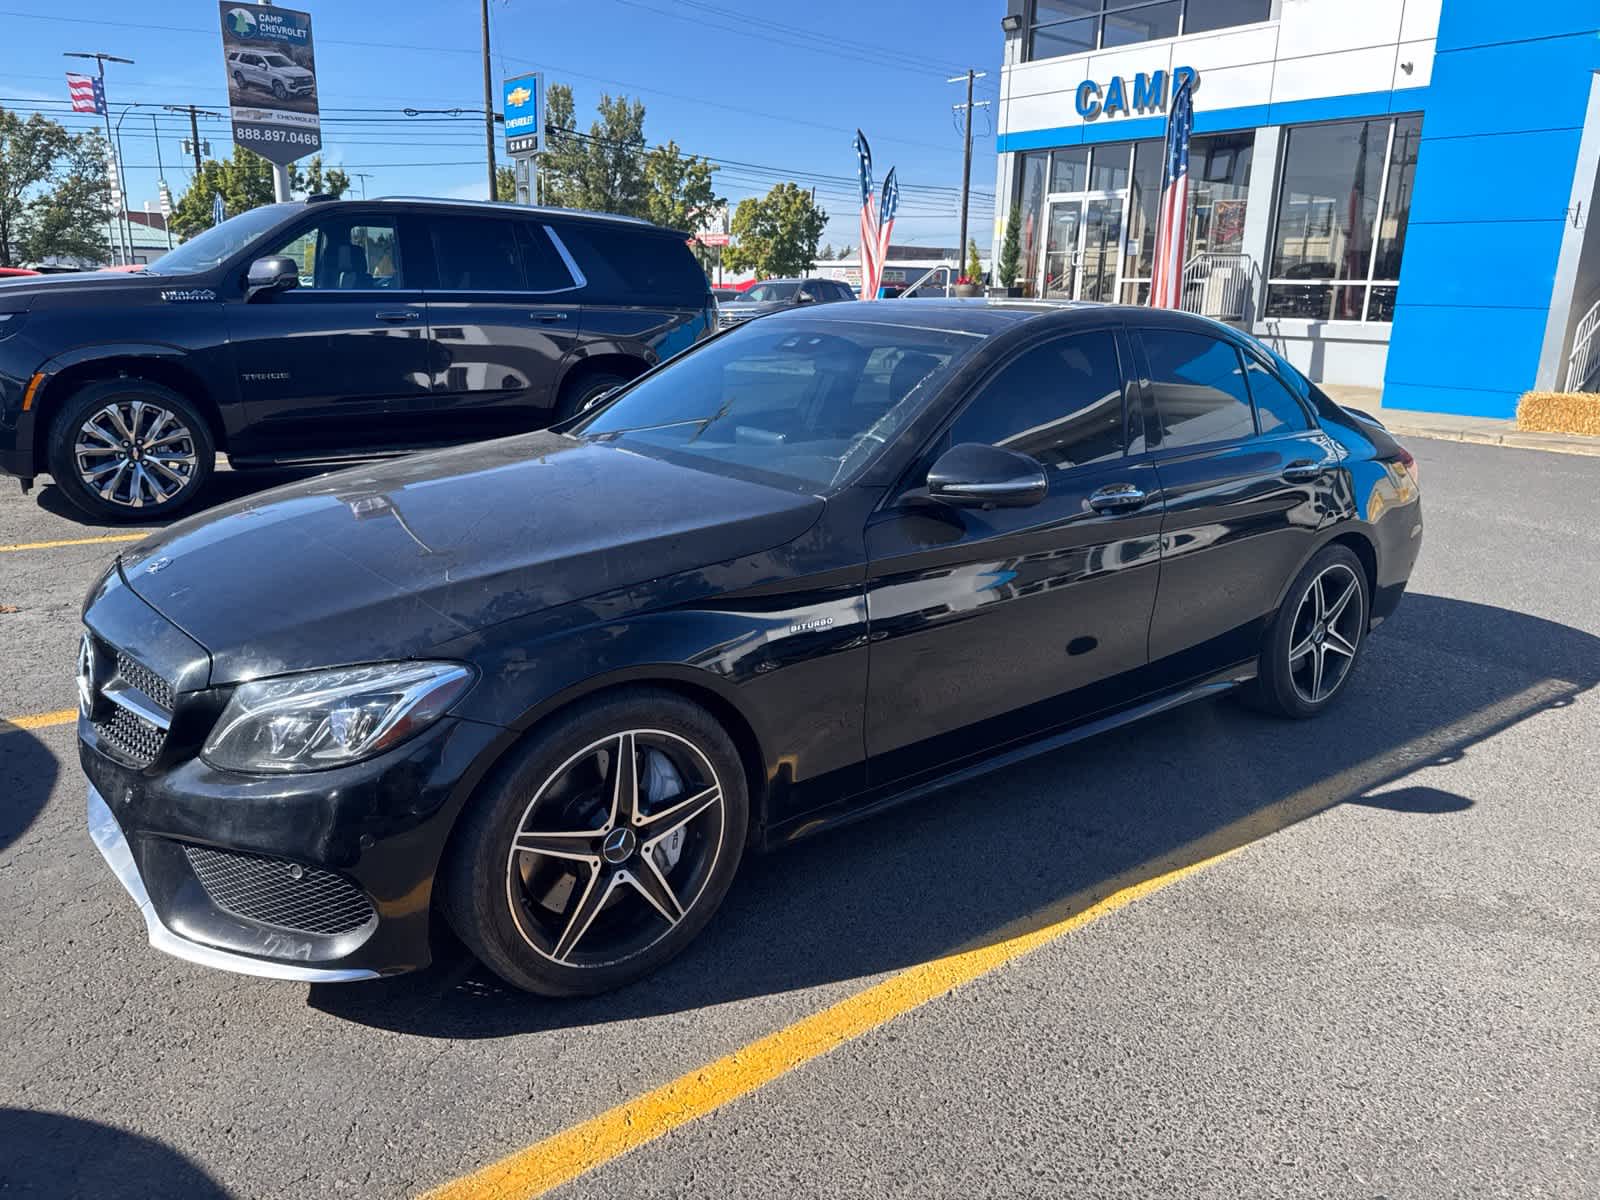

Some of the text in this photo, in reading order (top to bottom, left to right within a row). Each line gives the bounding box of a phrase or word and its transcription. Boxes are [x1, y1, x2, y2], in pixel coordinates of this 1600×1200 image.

[259, 14, 283, 24] CAMP
[260, 24, 307, 38] CHEVROLET
[276, 113, 318, 124] CHEVROLET
[510, 139, 533, 151] CAMP
[241, 372, 289, 381] TAHOE
[790, 617, 833, 633] BITURBO
